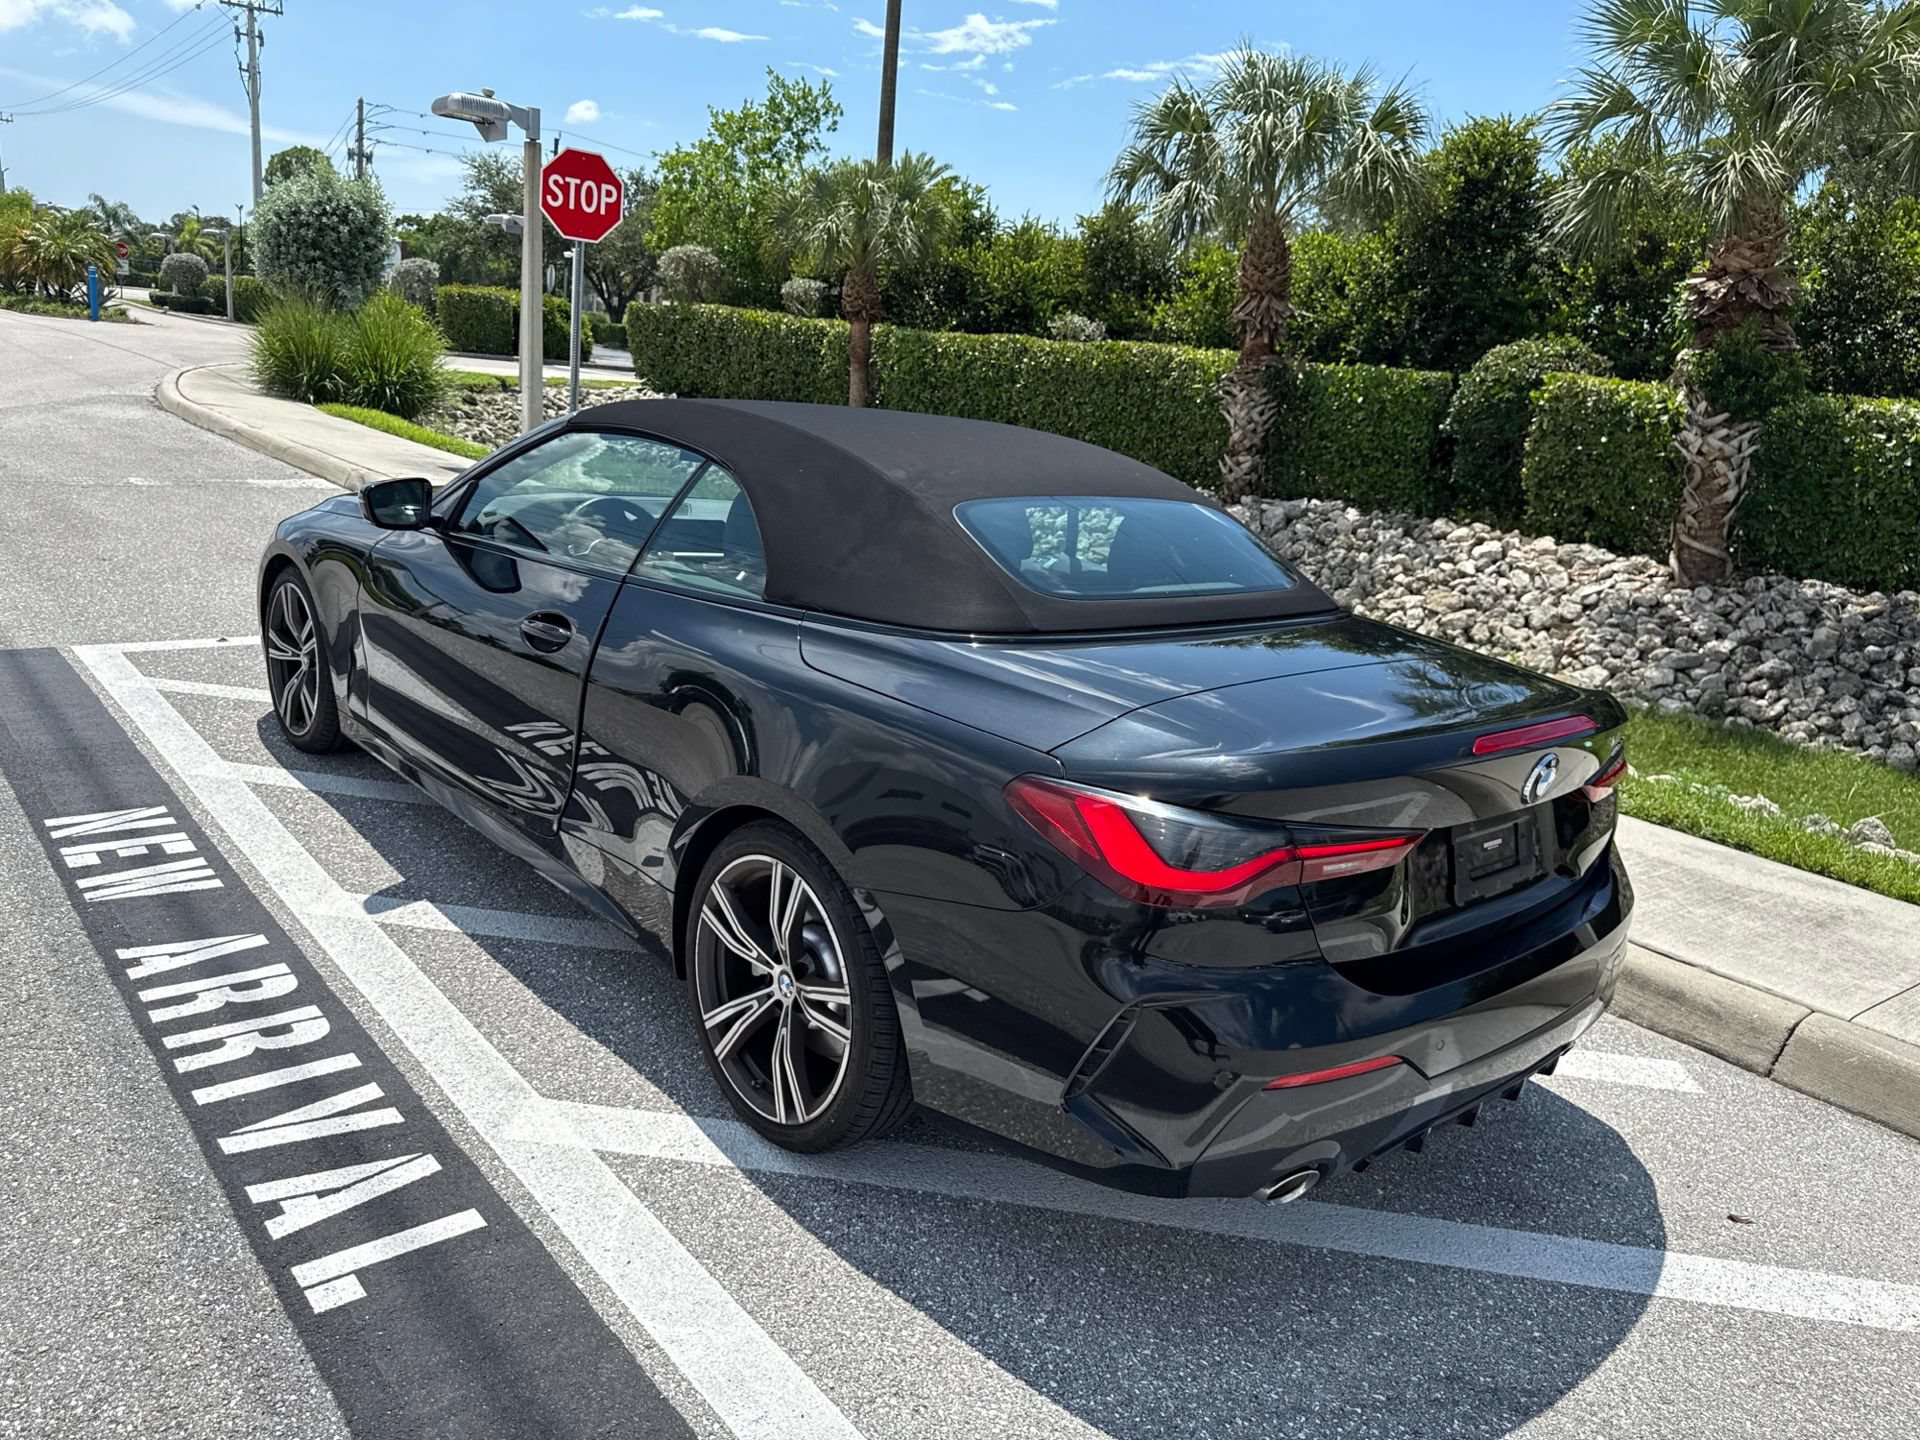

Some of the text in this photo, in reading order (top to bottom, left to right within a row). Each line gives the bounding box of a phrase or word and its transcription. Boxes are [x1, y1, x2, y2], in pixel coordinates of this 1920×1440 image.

[546, 174, 617, 215] STOP
[44, 805, 488, 1314] NEW ARRIVAL
